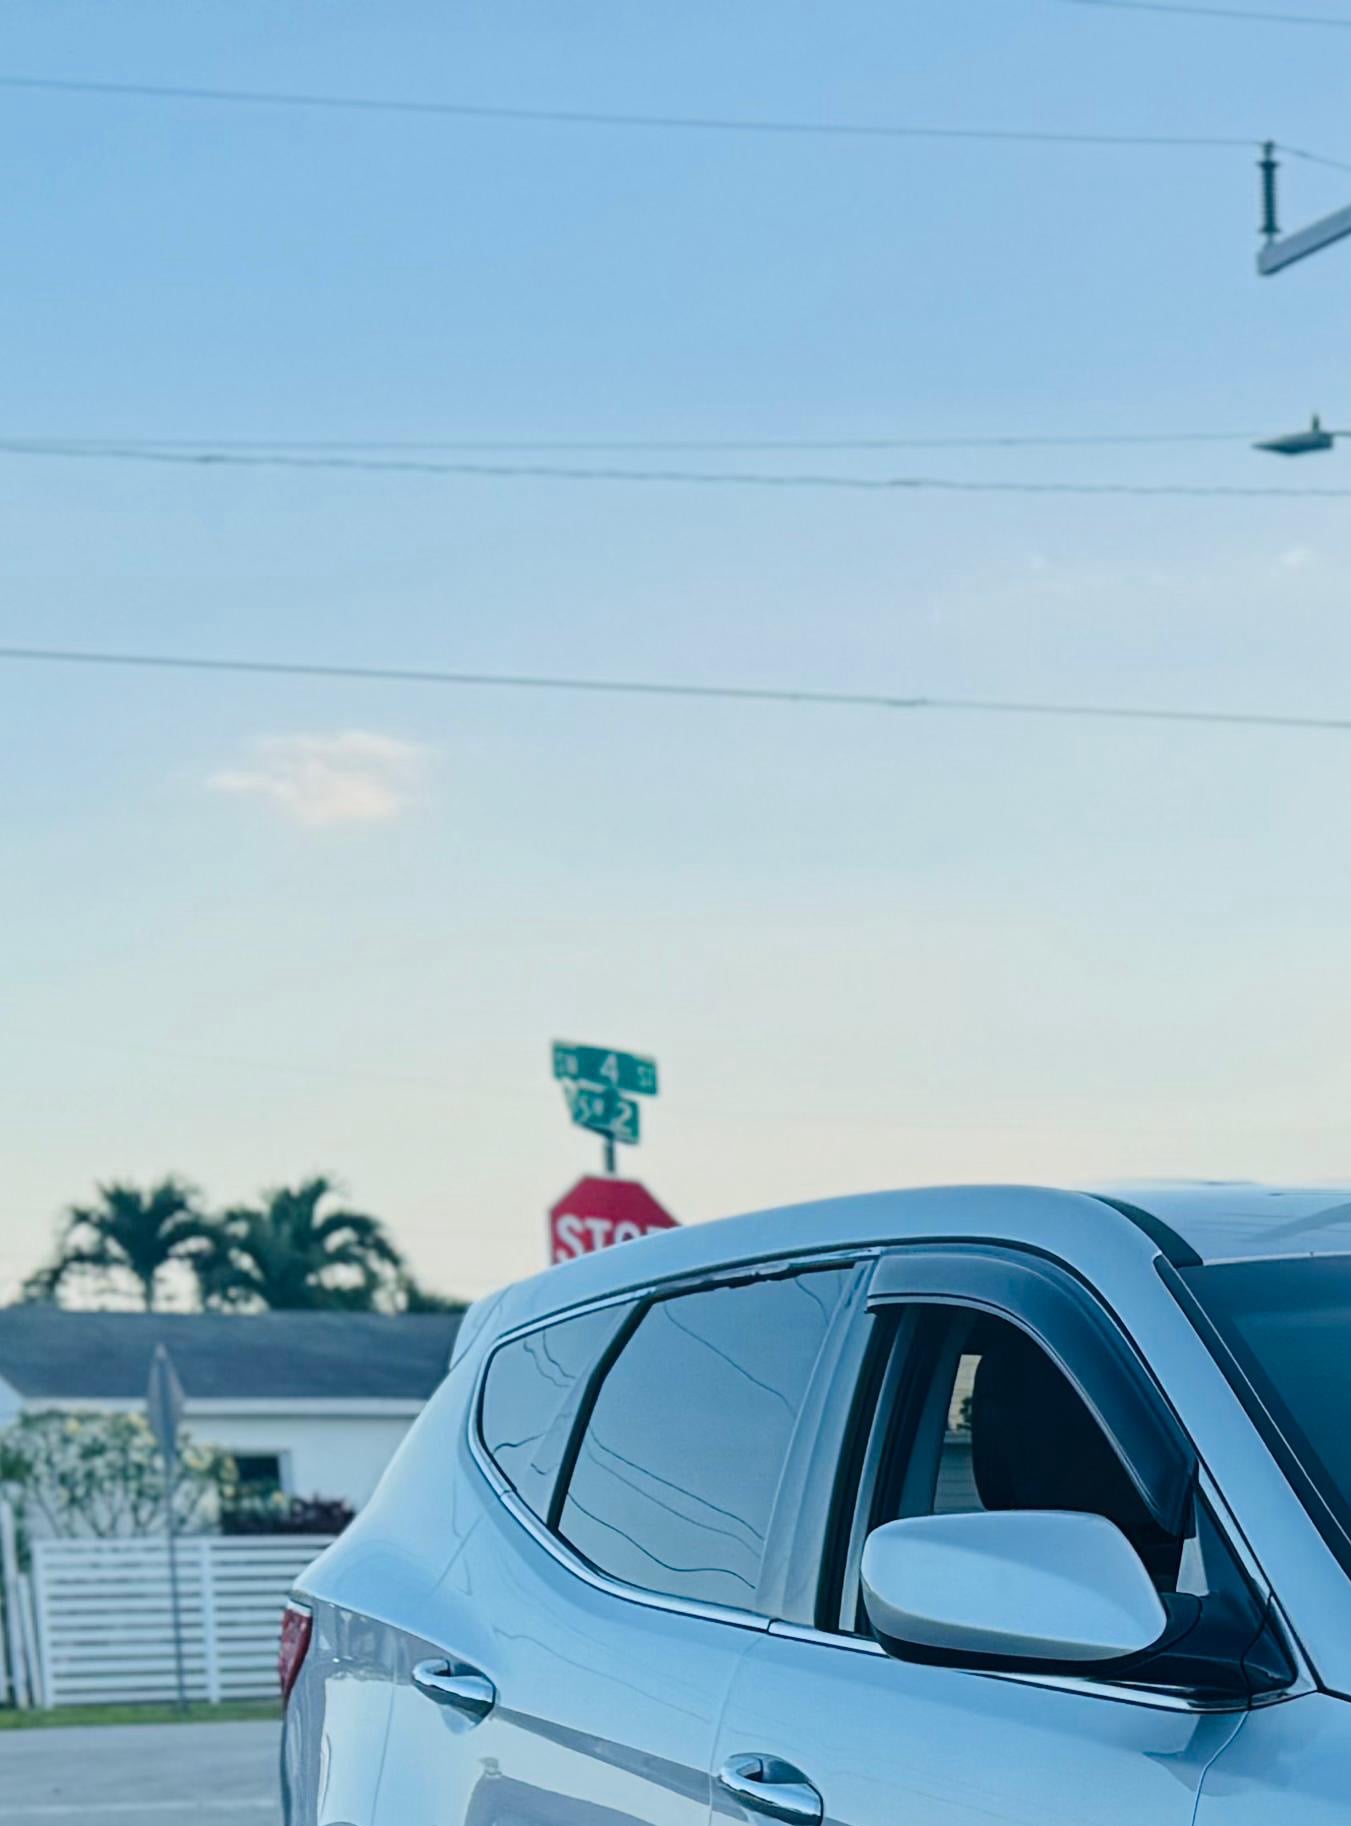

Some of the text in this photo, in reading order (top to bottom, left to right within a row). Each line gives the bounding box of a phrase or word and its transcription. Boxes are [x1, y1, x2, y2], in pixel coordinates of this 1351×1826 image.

[600, 1052, 619, 1086] 4
[611, 1101, 633, 1135] 2
[556, 1214, 668, 1262] ST
